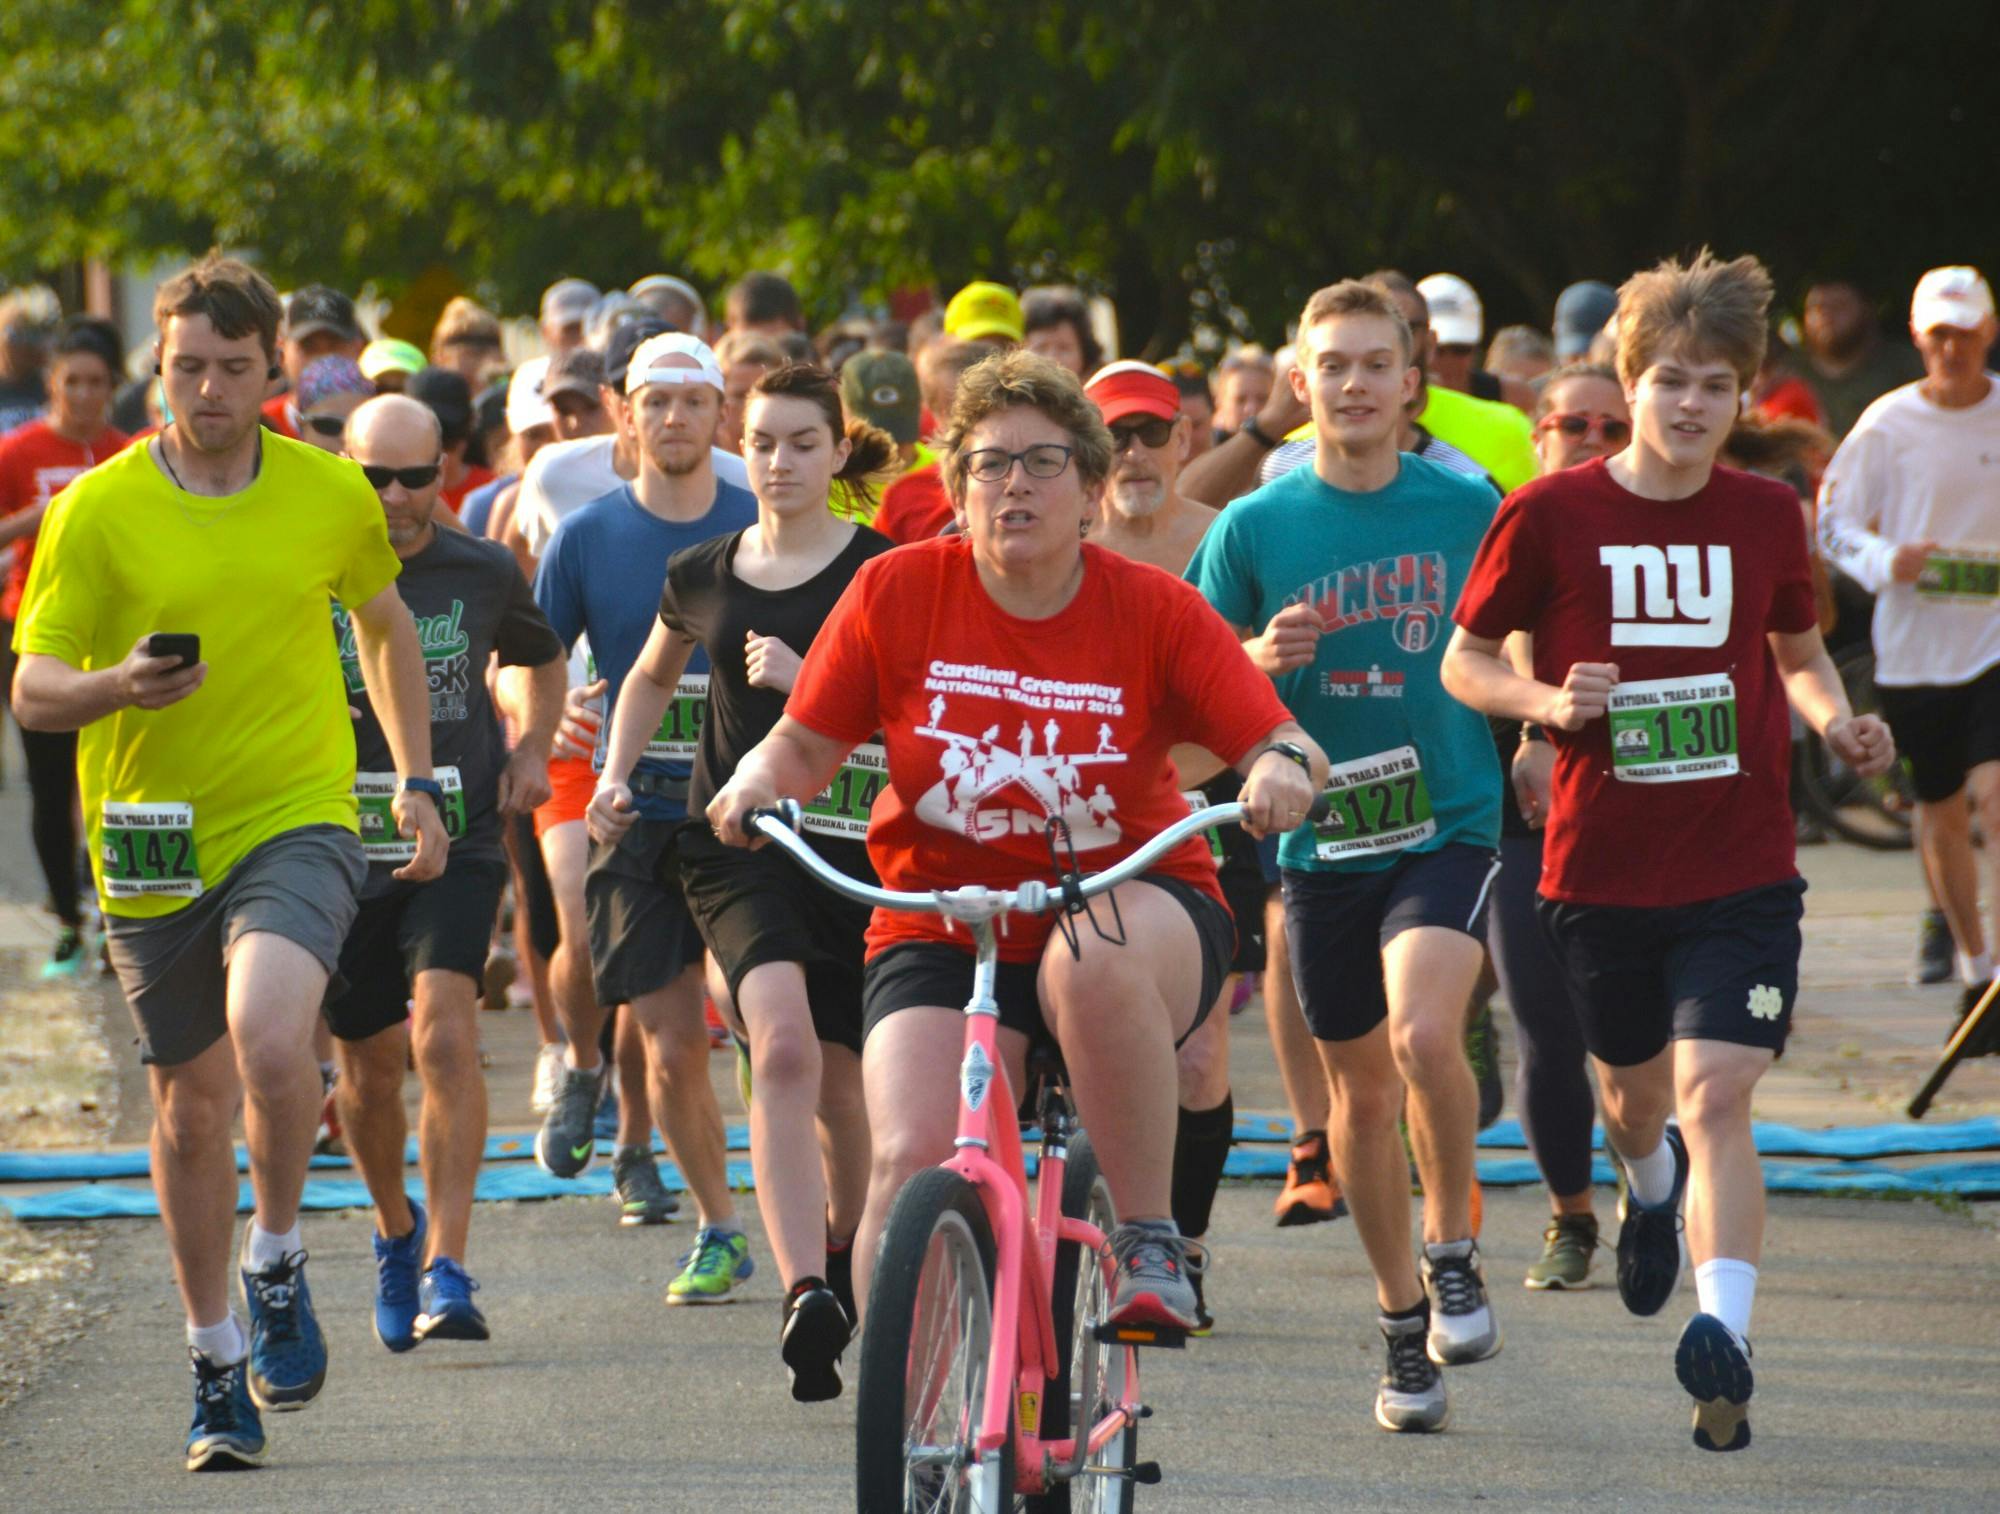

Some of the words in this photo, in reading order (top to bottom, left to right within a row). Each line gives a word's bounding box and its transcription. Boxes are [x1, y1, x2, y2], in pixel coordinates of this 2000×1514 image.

[678, 683, 706, 694] TRAILS
[929, 659, 1018, 686] Cardinal
[1019, 675, 1122, 703] Greenway
[925, 677, 1002, 699] NATIONAL
[1003, 687, 1052, 710] TRAILS
[1053, 698, 1086, 712] DAY
[1087, 699, 1125, 716] 2019
[1611, 693, 1660, 708] NATIONAL
[1662, 688, 1697, 703] TRAILS
[1699, 686, 1717, 699] DAY
[1719, 684, 1731, 697] 5K
[1654, 702, 1732, 761] 130
[850, 752, 881, 768] TRAILS
[1347, 766, 1381, 784] TRAILS
[1382, 759, 1400, 776] DAY
[1401, 756, 1416, 770] 5K
[1626, 765, 1674, 777] CARDINAL
[1675, 758, 1728, 774] GREENWAYS
[355, 783, 395, 794] NATIONAL
[1344, 774, 1418, 836] 127
[126, 814, 156, 826] TRAILS
[158, 814, 175, 826] DAY
[177, 814, 189, 826] 5K
[804, 815, 847, 831] CARDINAL
[1328, 839, 1372, 854] CARDINAL
[1373, 824, 1426, 846] GREENWAYS
[121, 830, 195, 877] 142
